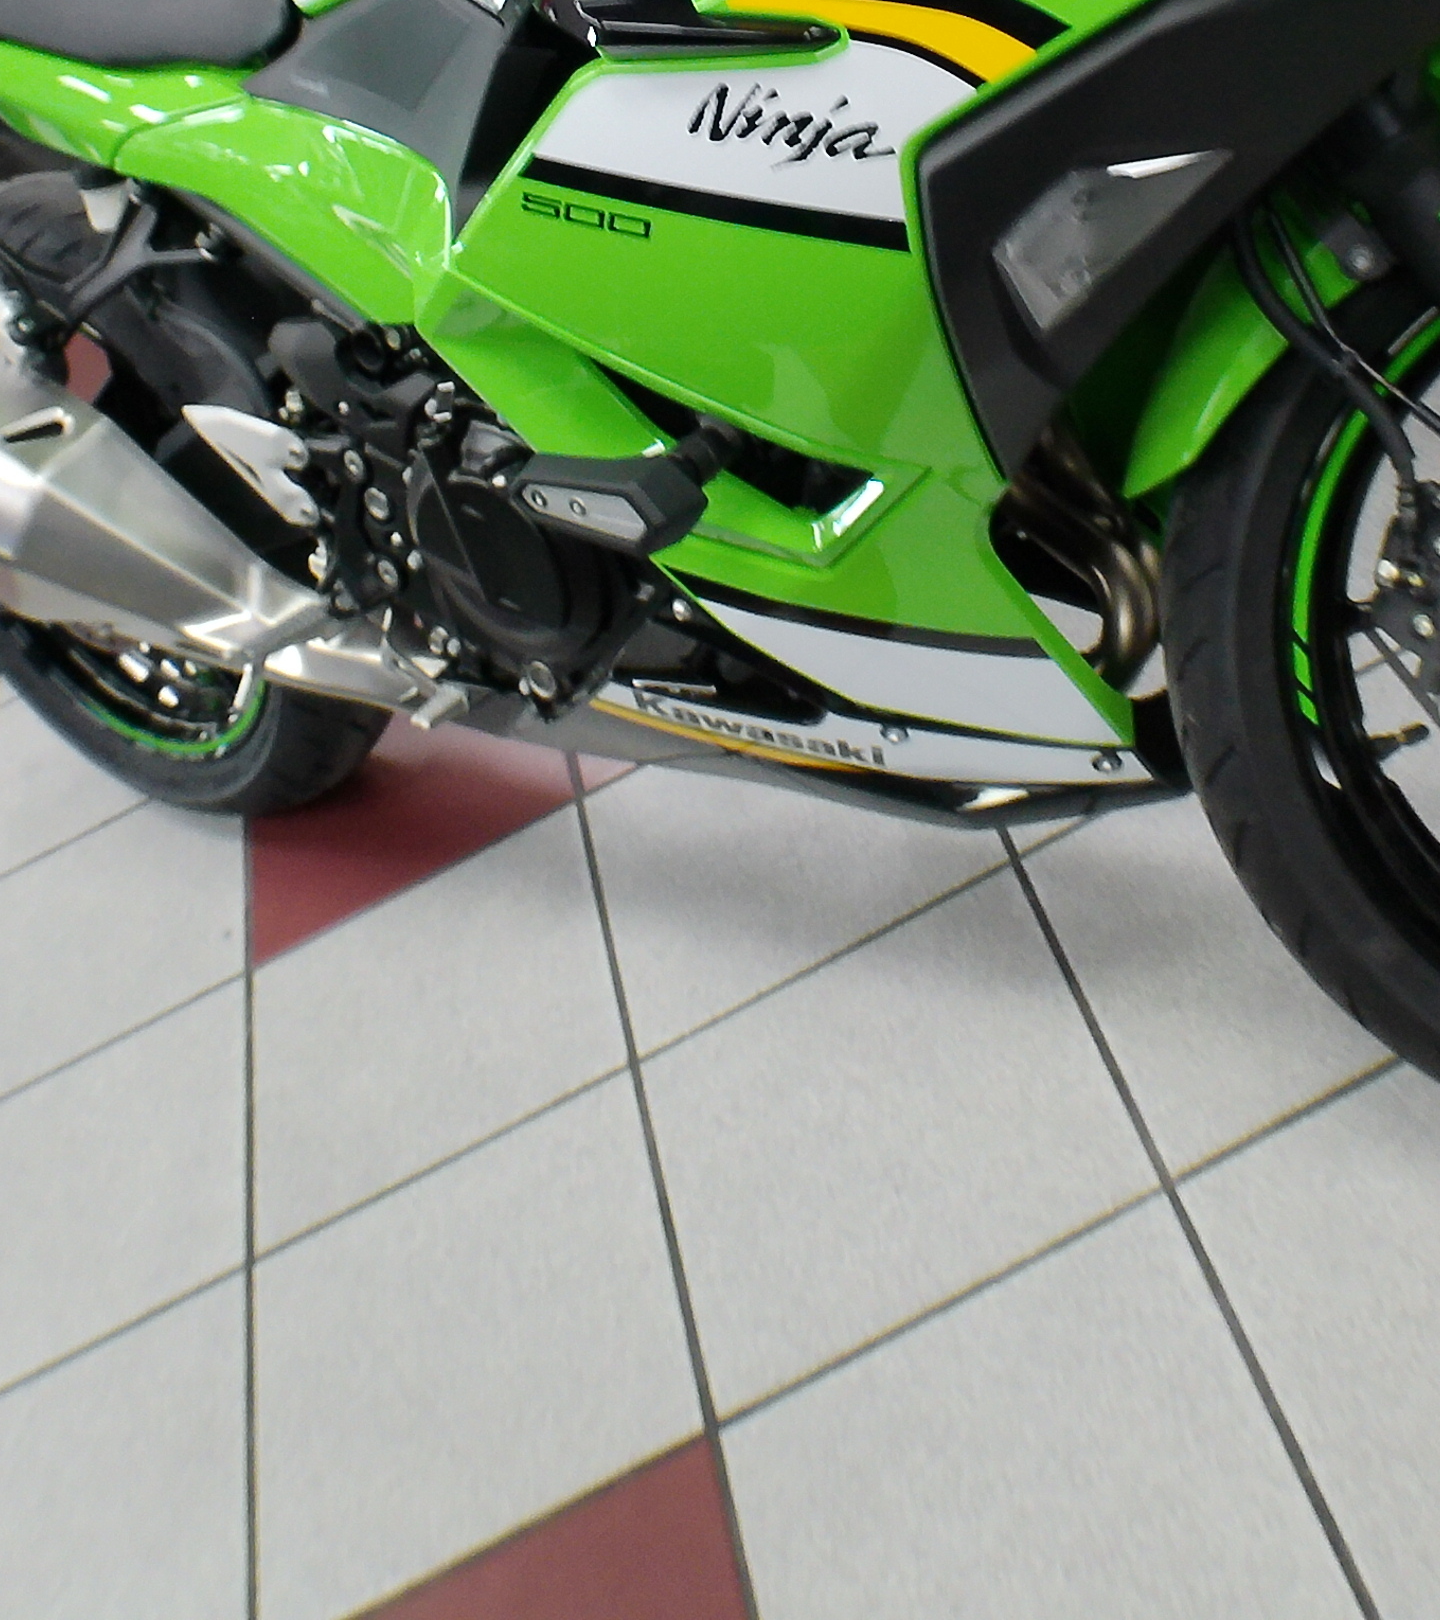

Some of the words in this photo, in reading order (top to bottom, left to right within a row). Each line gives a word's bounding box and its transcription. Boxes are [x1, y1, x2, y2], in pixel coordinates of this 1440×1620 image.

[686, 81, 896, 171] Ninja
[520, 190, 652, 240] 500
[632, 686, 887, 768] Kawasaki
